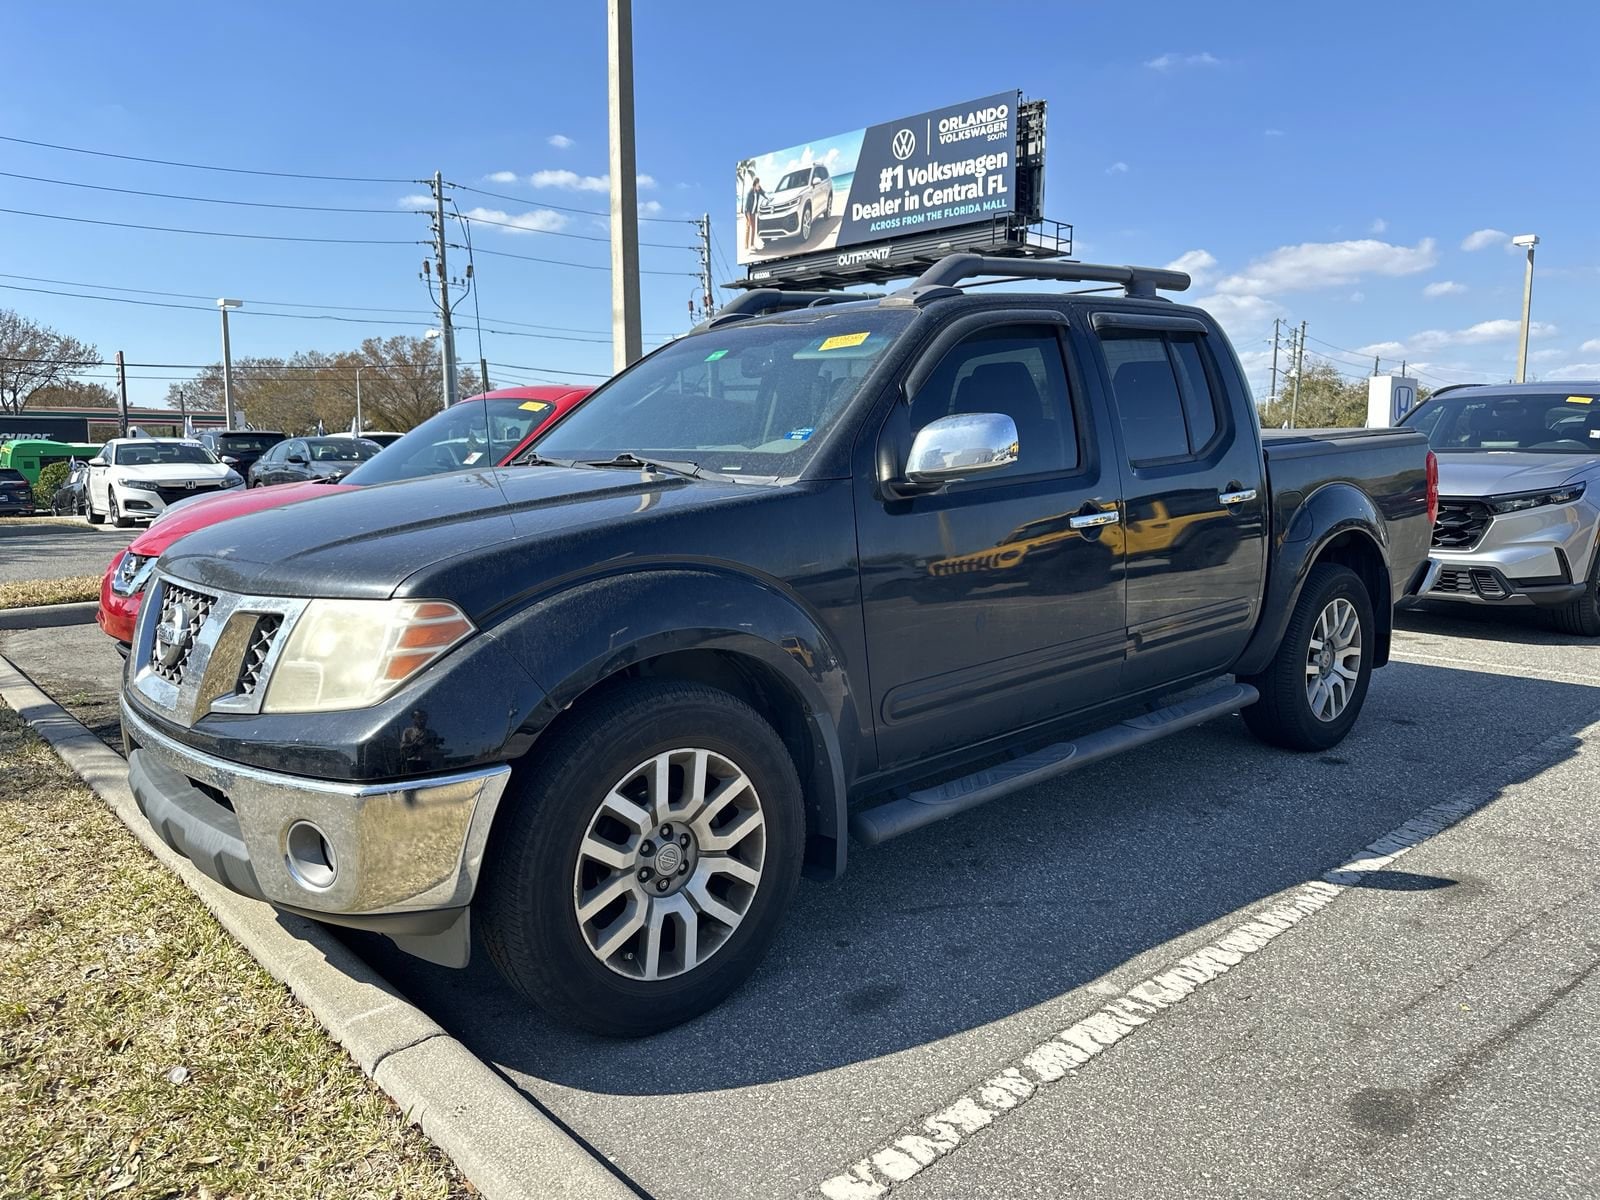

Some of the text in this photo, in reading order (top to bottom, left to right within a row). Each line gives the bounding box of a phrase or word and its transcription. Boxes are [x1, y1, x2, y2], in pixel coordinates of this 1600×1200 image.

[939, 104, 1008, 132] ORLANDO
[939, 120, 1008, 145] VOLKSWAGEN
[987, 132, 1007, 141] SOUTH
[879, 152, 1008, 193] #1 Volkswagen
[852, 173, 1008, 221] Dealer in Central FL
[870, 198, 1007, 232] ACROSS FROM THE FLORIDA MALL
